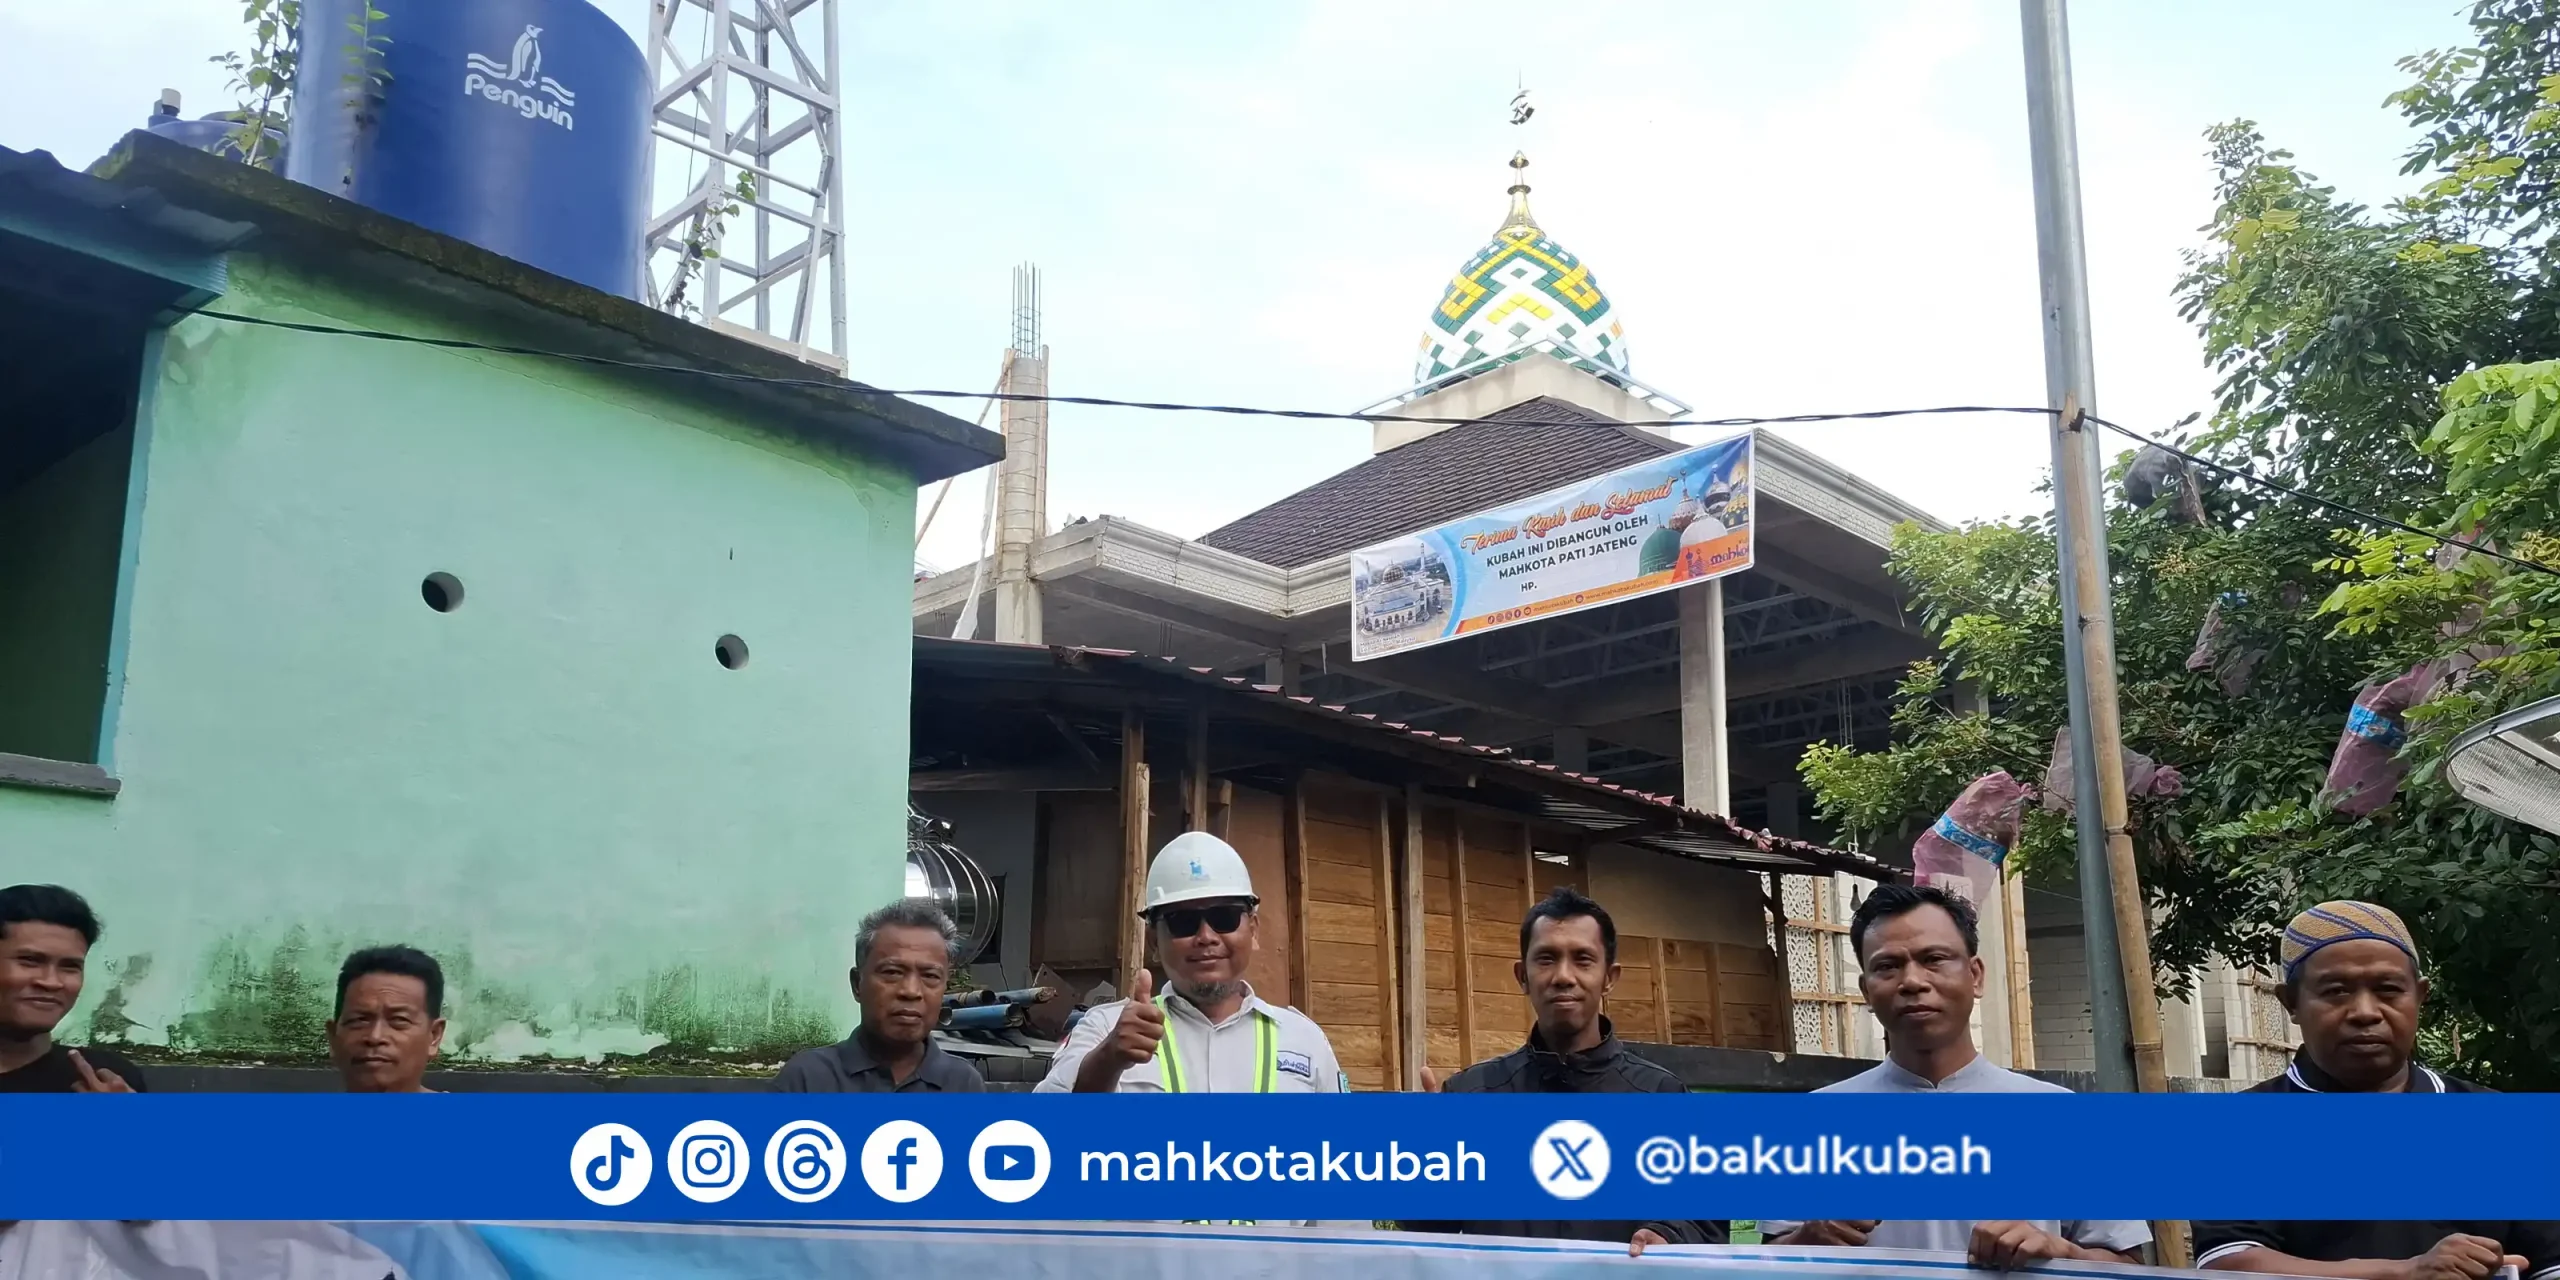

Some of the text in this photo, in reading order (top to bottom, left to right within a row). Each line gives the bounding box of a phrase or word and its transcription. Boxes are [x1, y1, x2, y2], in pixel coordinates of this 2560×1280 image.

[464, 73, 573, 131] Penguin
[1460, 476, 1678, 555] Terima Kasih dan Selamat
[1486, 514, 1649, 567] KUBAH INI DIBANGUN OLEH
[1498, 535, 1638, 580] MAHKOTA PATI JATENG
[1520, 580, 1538, 593] HP.
